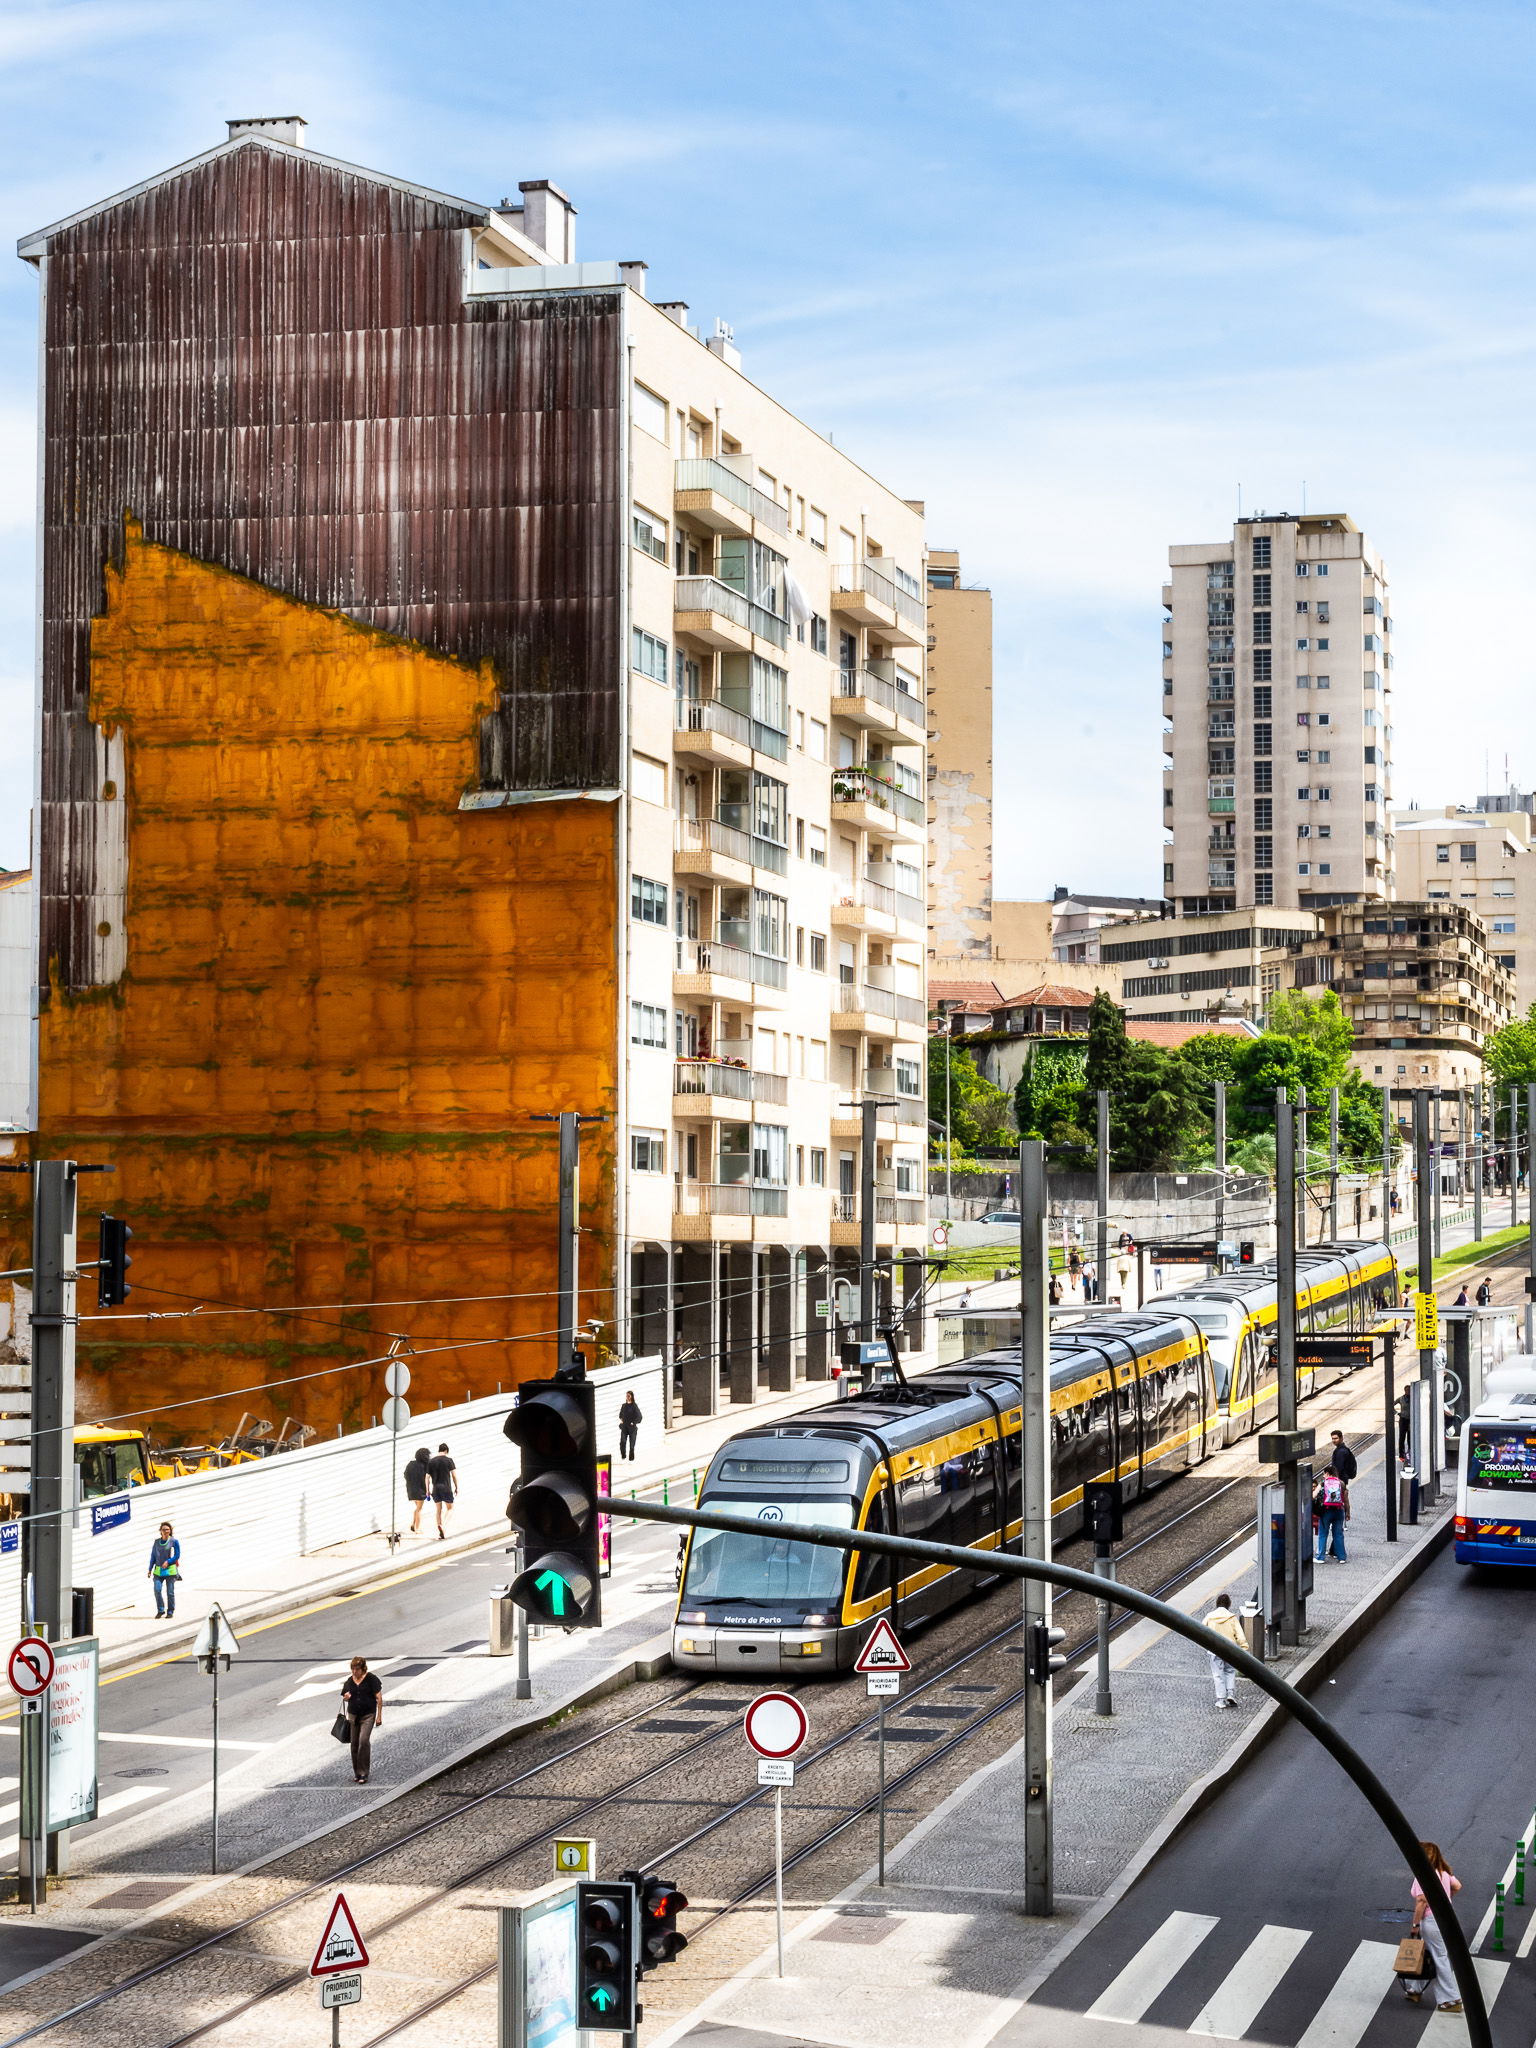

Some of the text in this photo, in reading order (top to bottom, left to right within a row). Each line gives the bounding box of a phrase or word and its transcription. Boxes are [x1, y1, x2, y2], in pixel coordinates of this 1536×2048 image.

[1484, 1462, 1521, 1471] PRÓXIMA
[1479, 1470, 1522, 1479] BOWLING
[723, 1616, 782, 1624] Metro do Porto
[326, 1978, 360, 1992] PRIORIDADE
[332, 1991, 353, 2002] METRO
